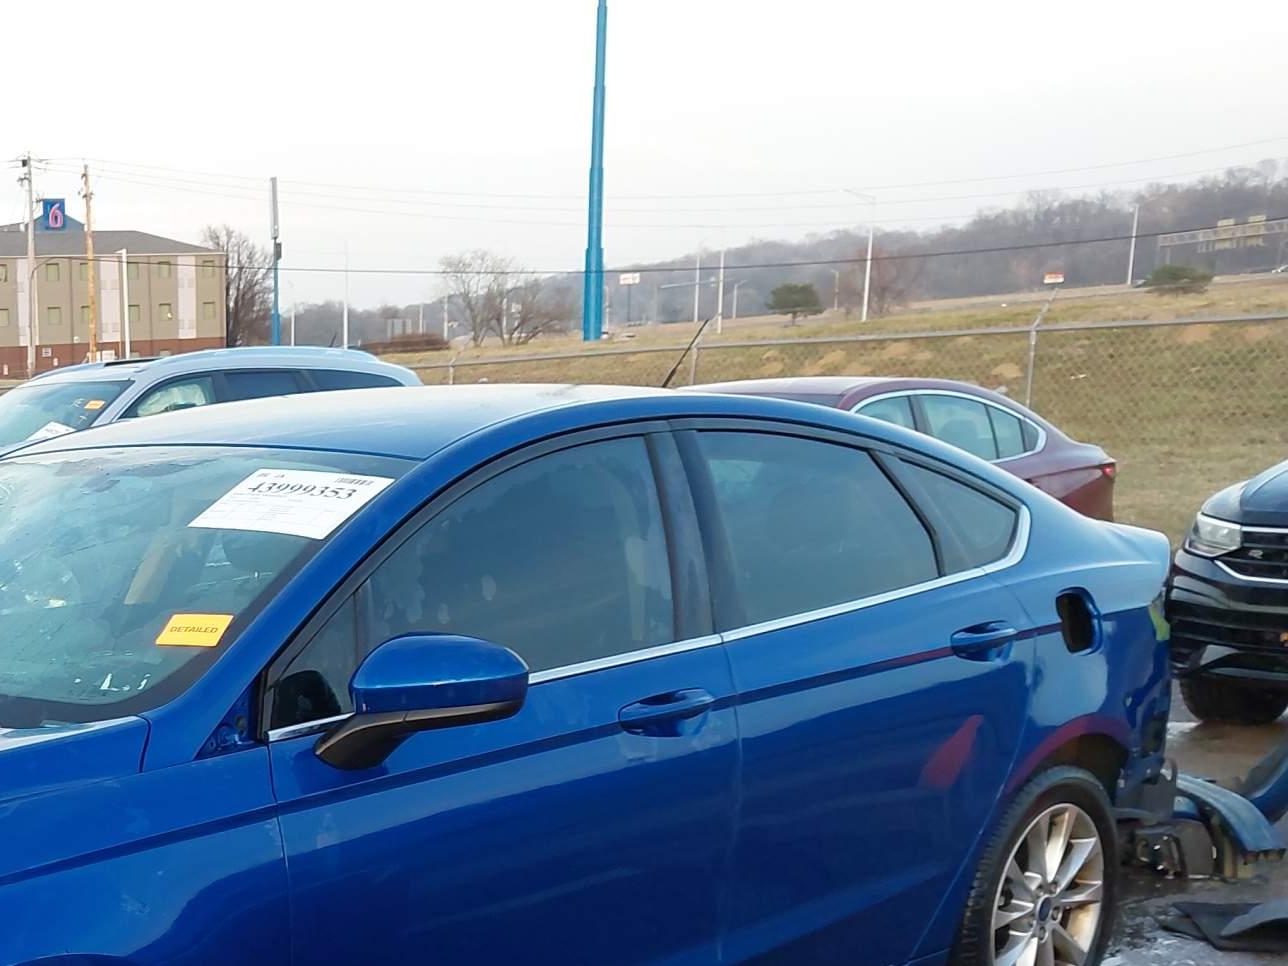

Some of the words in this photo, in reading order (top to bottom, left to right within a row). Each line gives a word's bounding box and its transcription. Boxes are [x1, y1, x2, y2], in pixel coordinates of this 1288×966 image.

[49, 203, 63, 227] 6
[248, 481, 358, 499] 43999353
[170, 626, 219, 634] DETAILED
